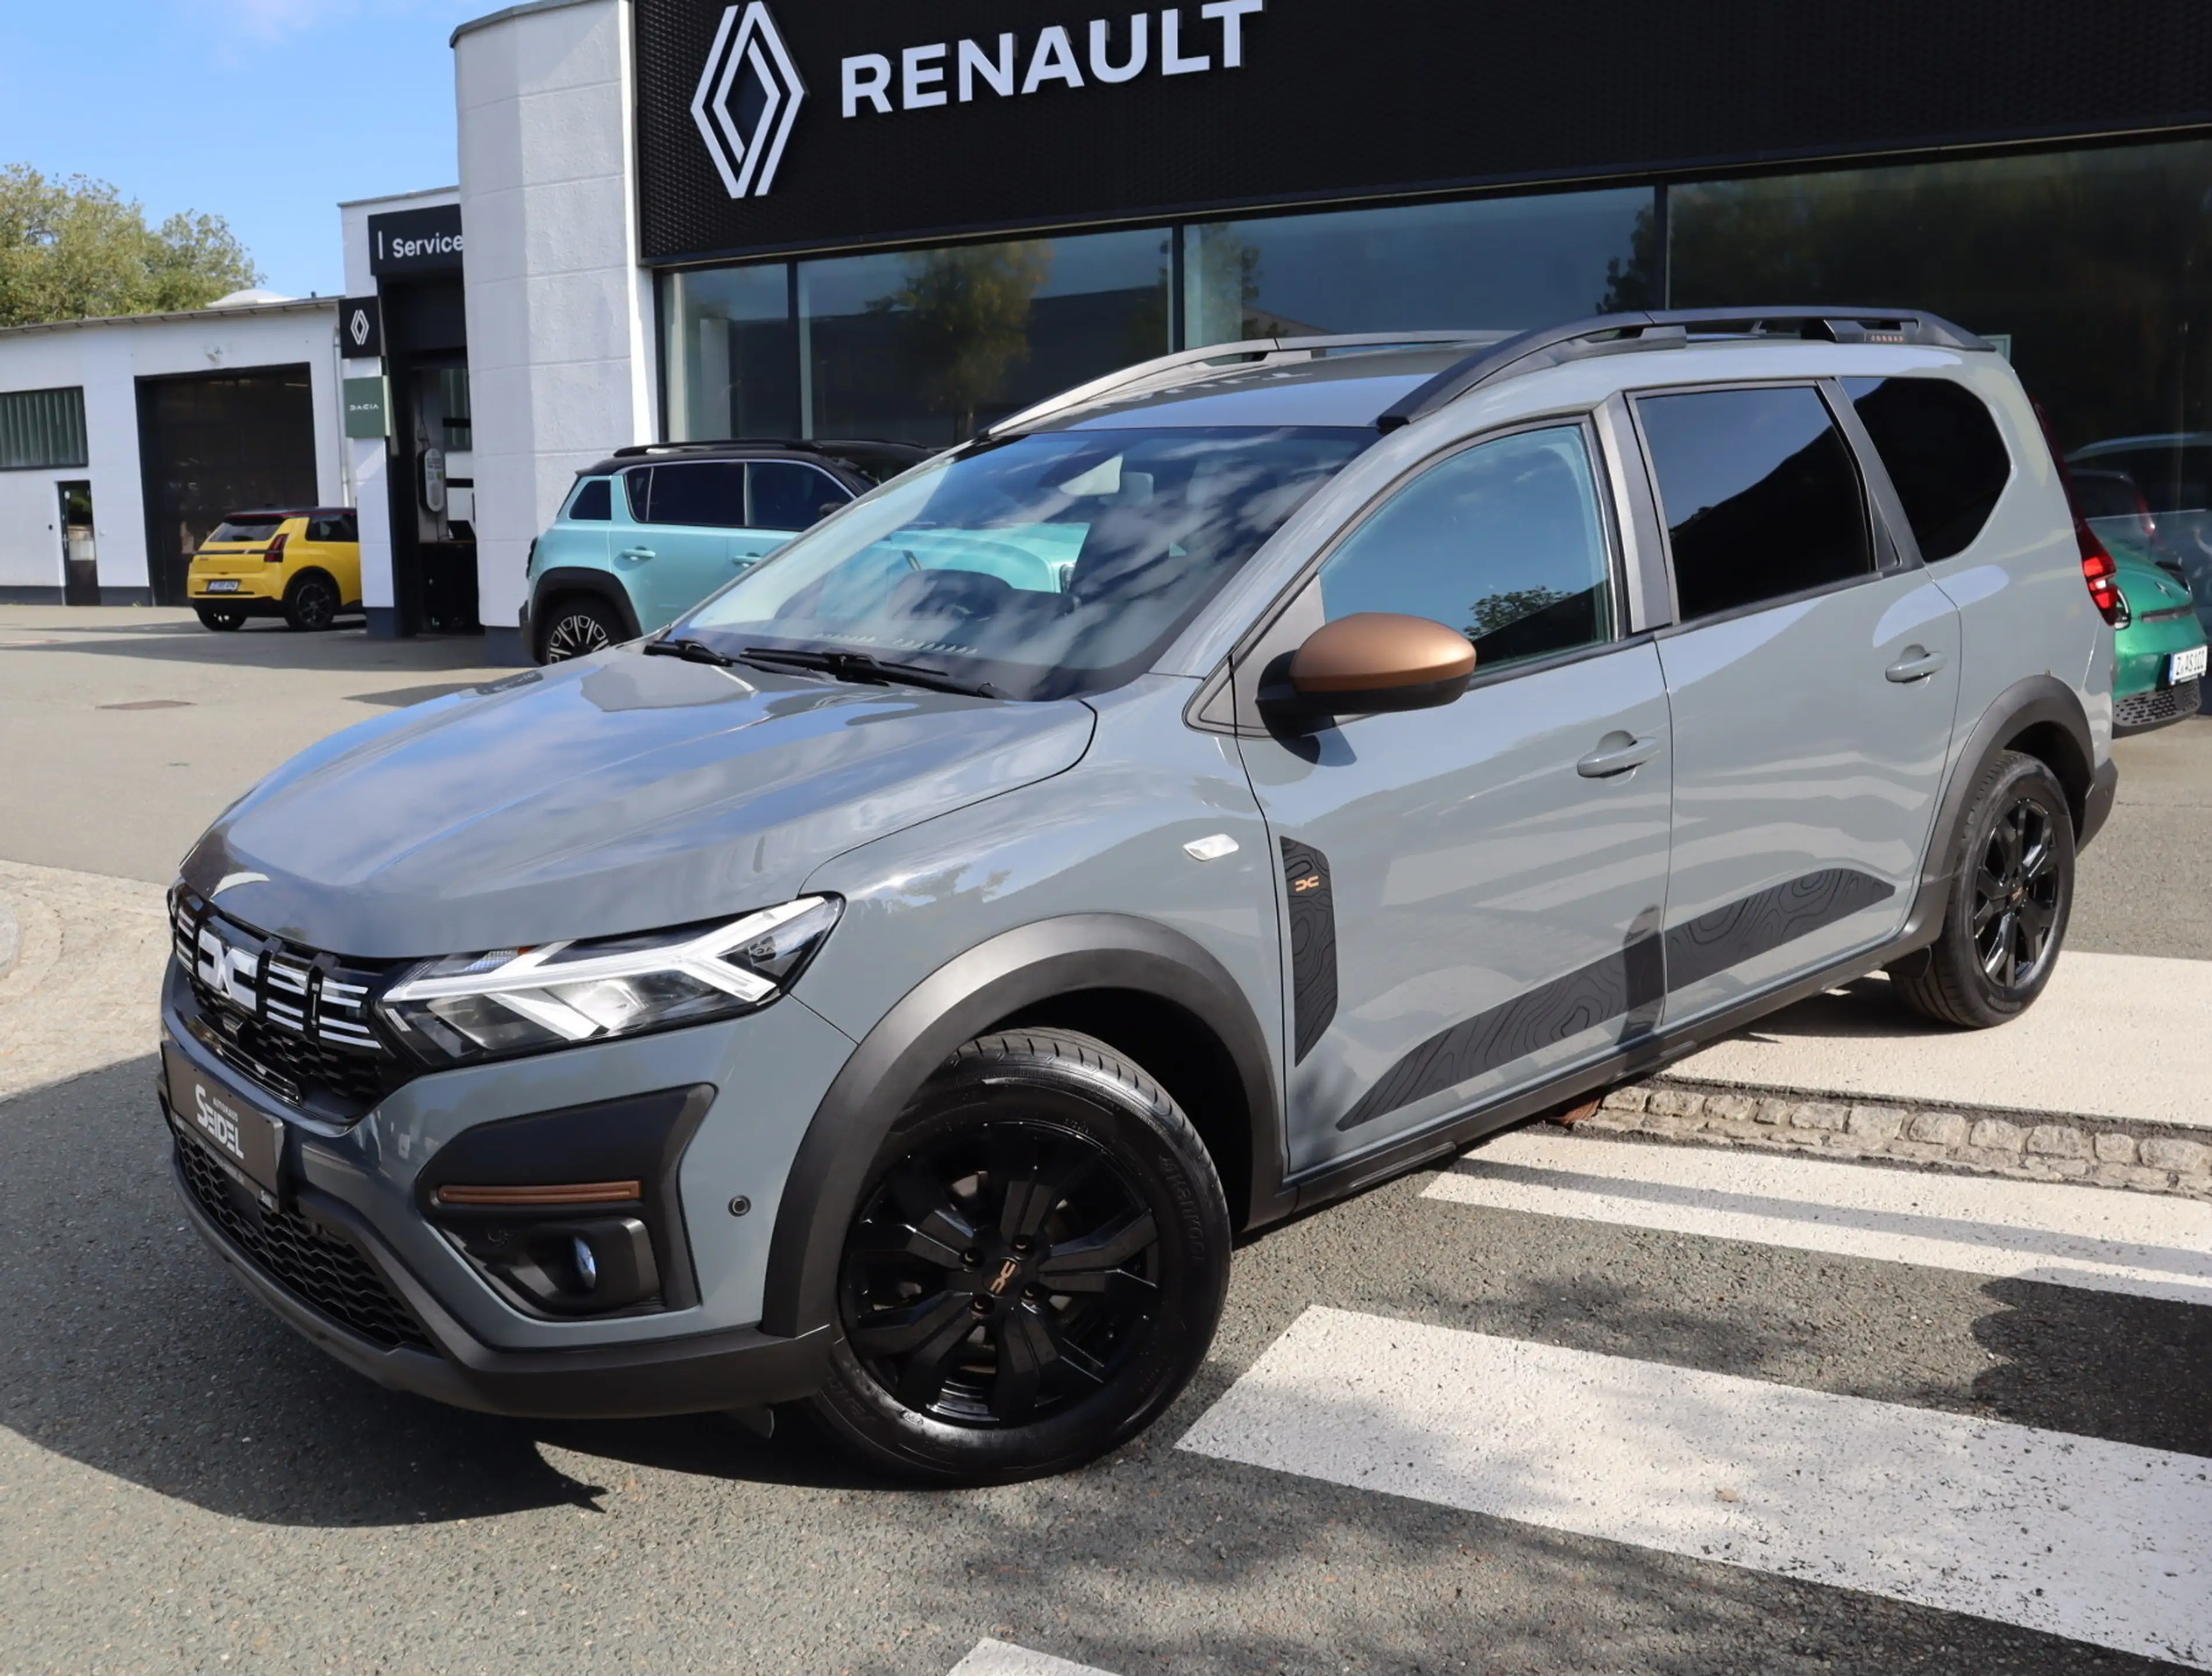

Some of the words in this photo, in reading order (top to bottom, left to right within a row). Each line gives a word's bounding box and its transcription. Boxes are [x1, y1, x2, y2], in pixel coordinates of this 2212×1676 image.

[842, 0, 1263, 118] RENAULT
[392, 232, 463, 258] Service
[195, 1084, 244, 1160] SEIDEL
